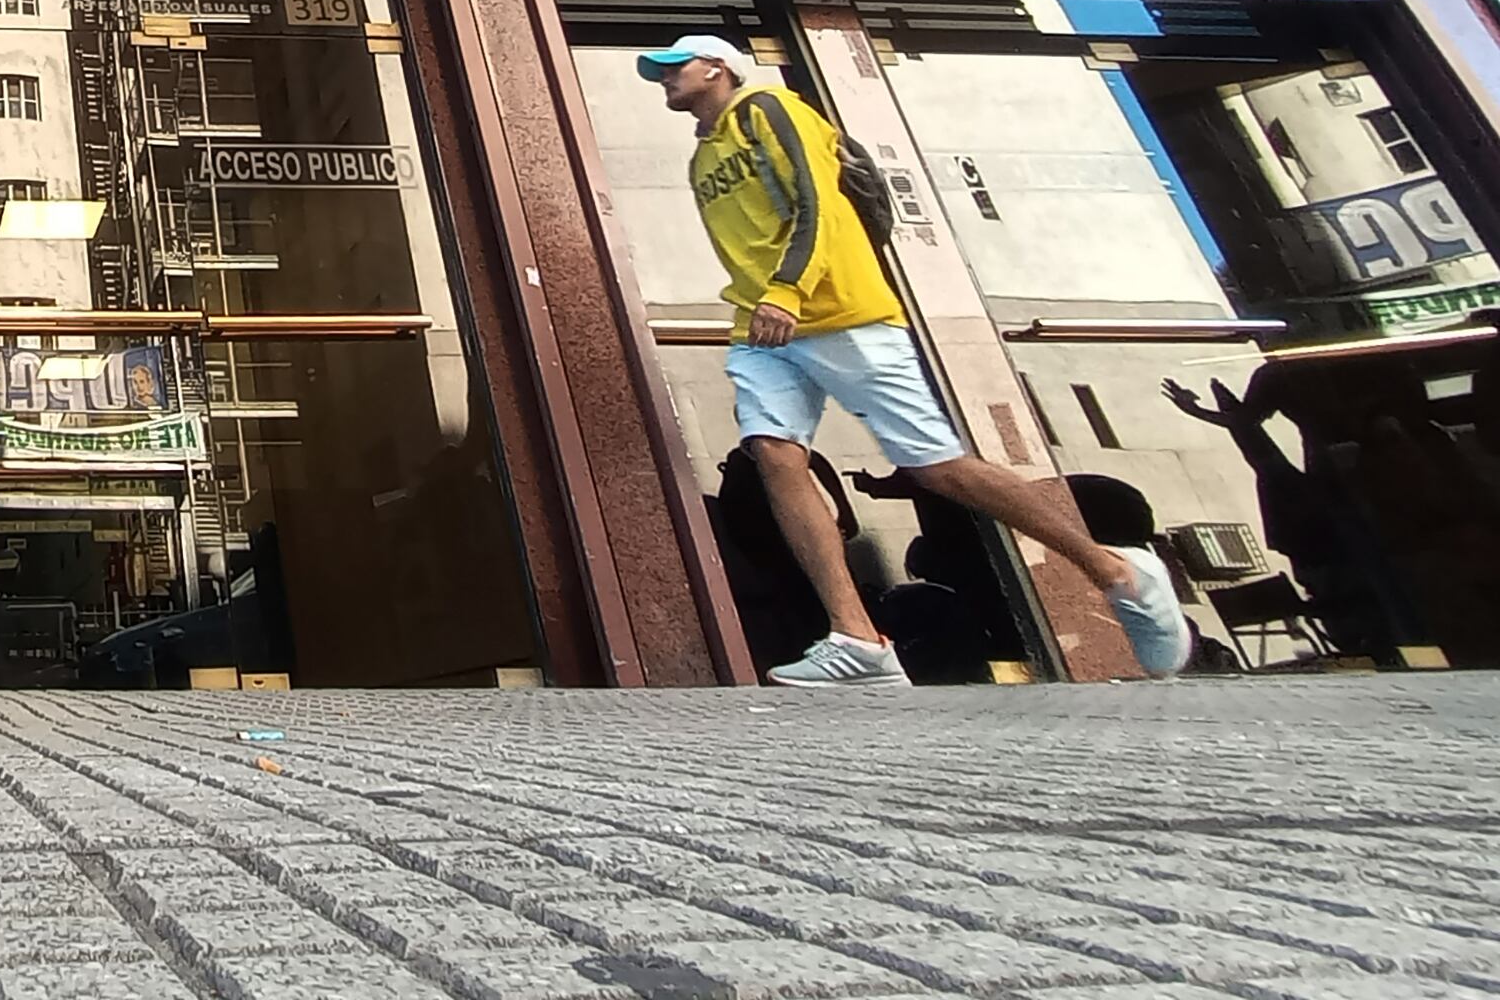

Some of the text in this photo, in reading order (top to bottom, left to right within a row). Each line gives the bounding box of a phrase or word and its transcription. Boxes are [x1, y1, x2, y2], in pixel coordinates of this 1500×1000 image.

[127, 0, 272, 15] AUDIOVSUALES
[199, 150, 415, 182] ACCESO PUBLICO
